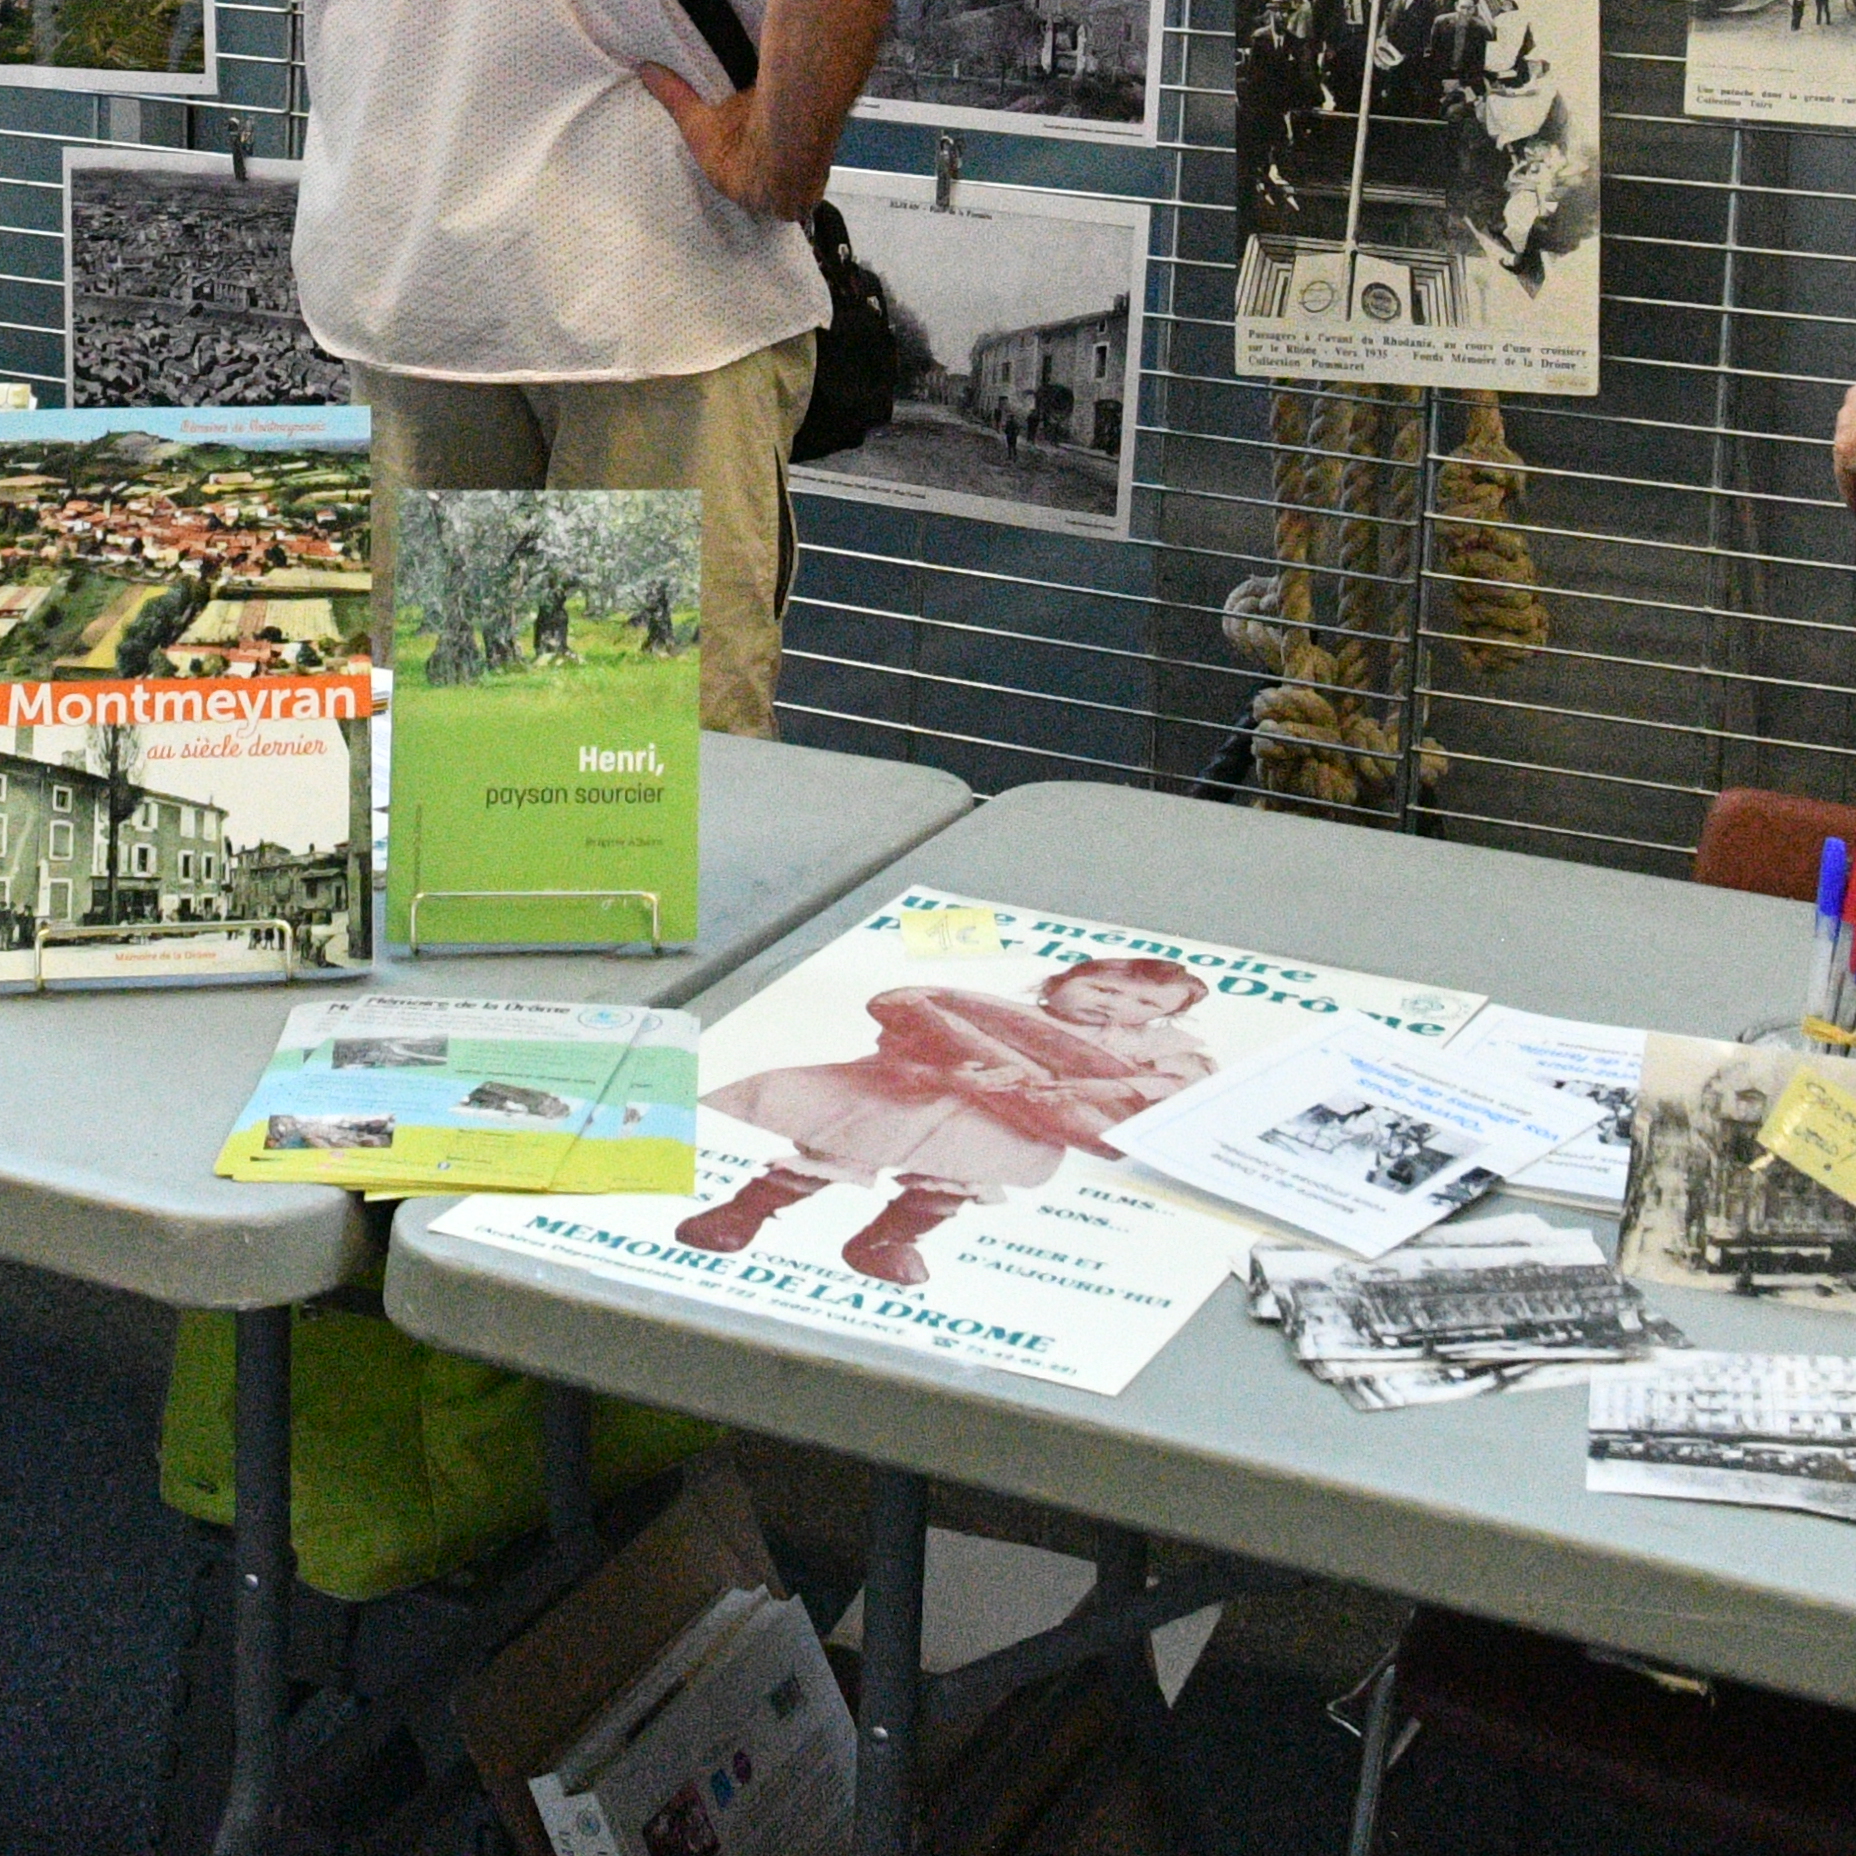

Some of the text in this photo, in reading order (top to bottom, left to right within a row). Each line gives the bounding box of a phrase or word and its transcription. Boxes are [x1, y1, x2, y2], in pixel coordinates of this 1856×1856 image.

[7, 682, 356, 739] Montmeyran
[147, 734, 327, 760] au siècle dernier
[578, 742, 664, 777] Henri,
[486, 782, 665, 810] paysan sourcier
[902, 896, 1318, 983] ue mémoire
[1033, 935, 1095, 964] la
[526, 1214, 1056, 1353] MEMOIRE DE LA DROME
